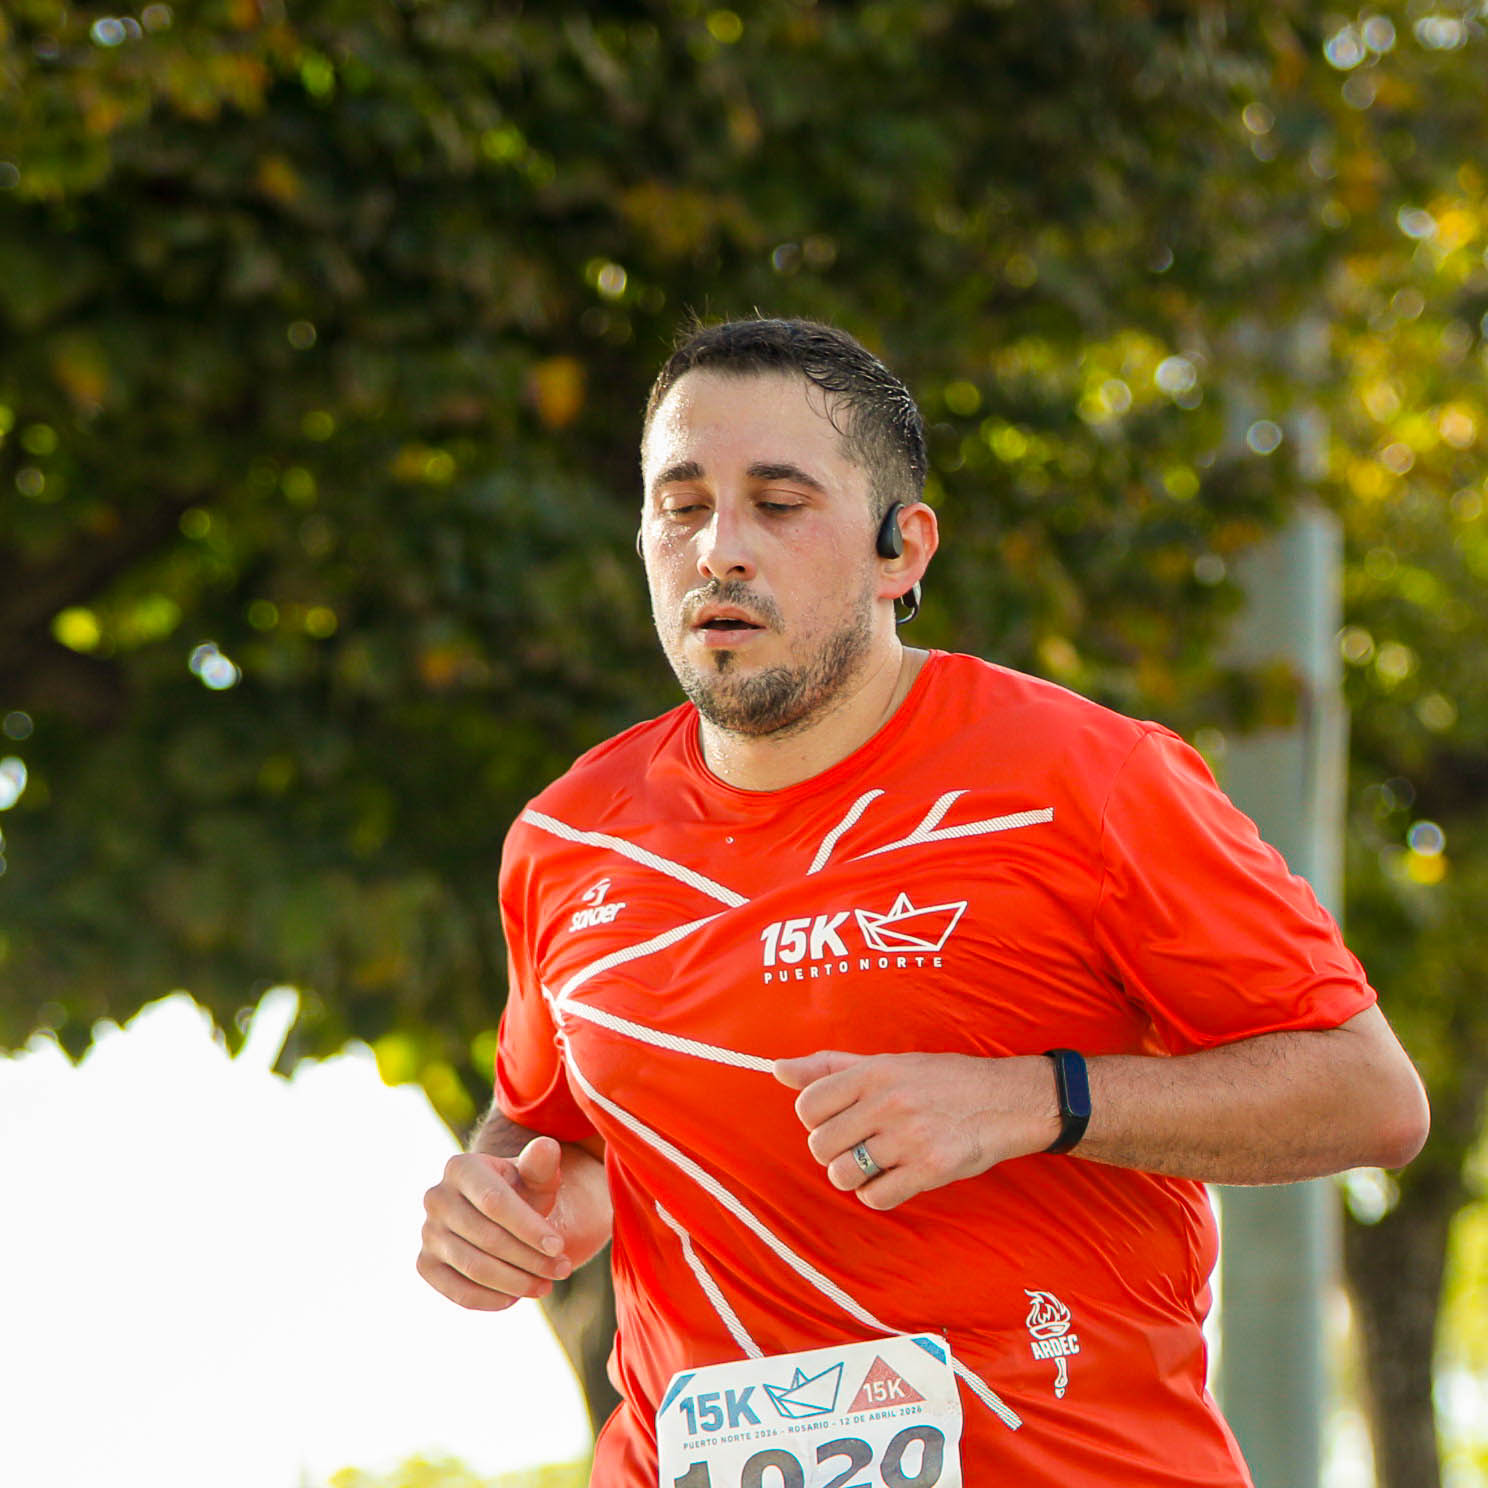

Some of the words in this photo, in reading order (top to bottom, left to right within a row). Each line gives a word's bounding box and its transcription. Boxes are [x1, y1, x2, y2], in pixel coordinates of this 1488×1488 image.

[760, 911, 850, 967] 15K
[764, 961, 849, 985] PUERTO
[859, 956, 943, 970] NORTE
[1030, 1334, 1080, 1360] ARDEC
[863, 1377, 905, 1403] 15K
[680, 1386, 761, 1436] 15K
[683, 1438, 718, 1450] PUERTO
[721, 1432, 751, 1443] NORTE
[754, 1429, 778, 1439] 2026
[788, 1421, 829, 1433] ROSARIO
[839, 1416, 850, 1425] 12
[853, 1415, 865, 1424] DE
[869, 1410, 897, 1421] ABRIL
[900, 1405, 922, 1416] 2026
